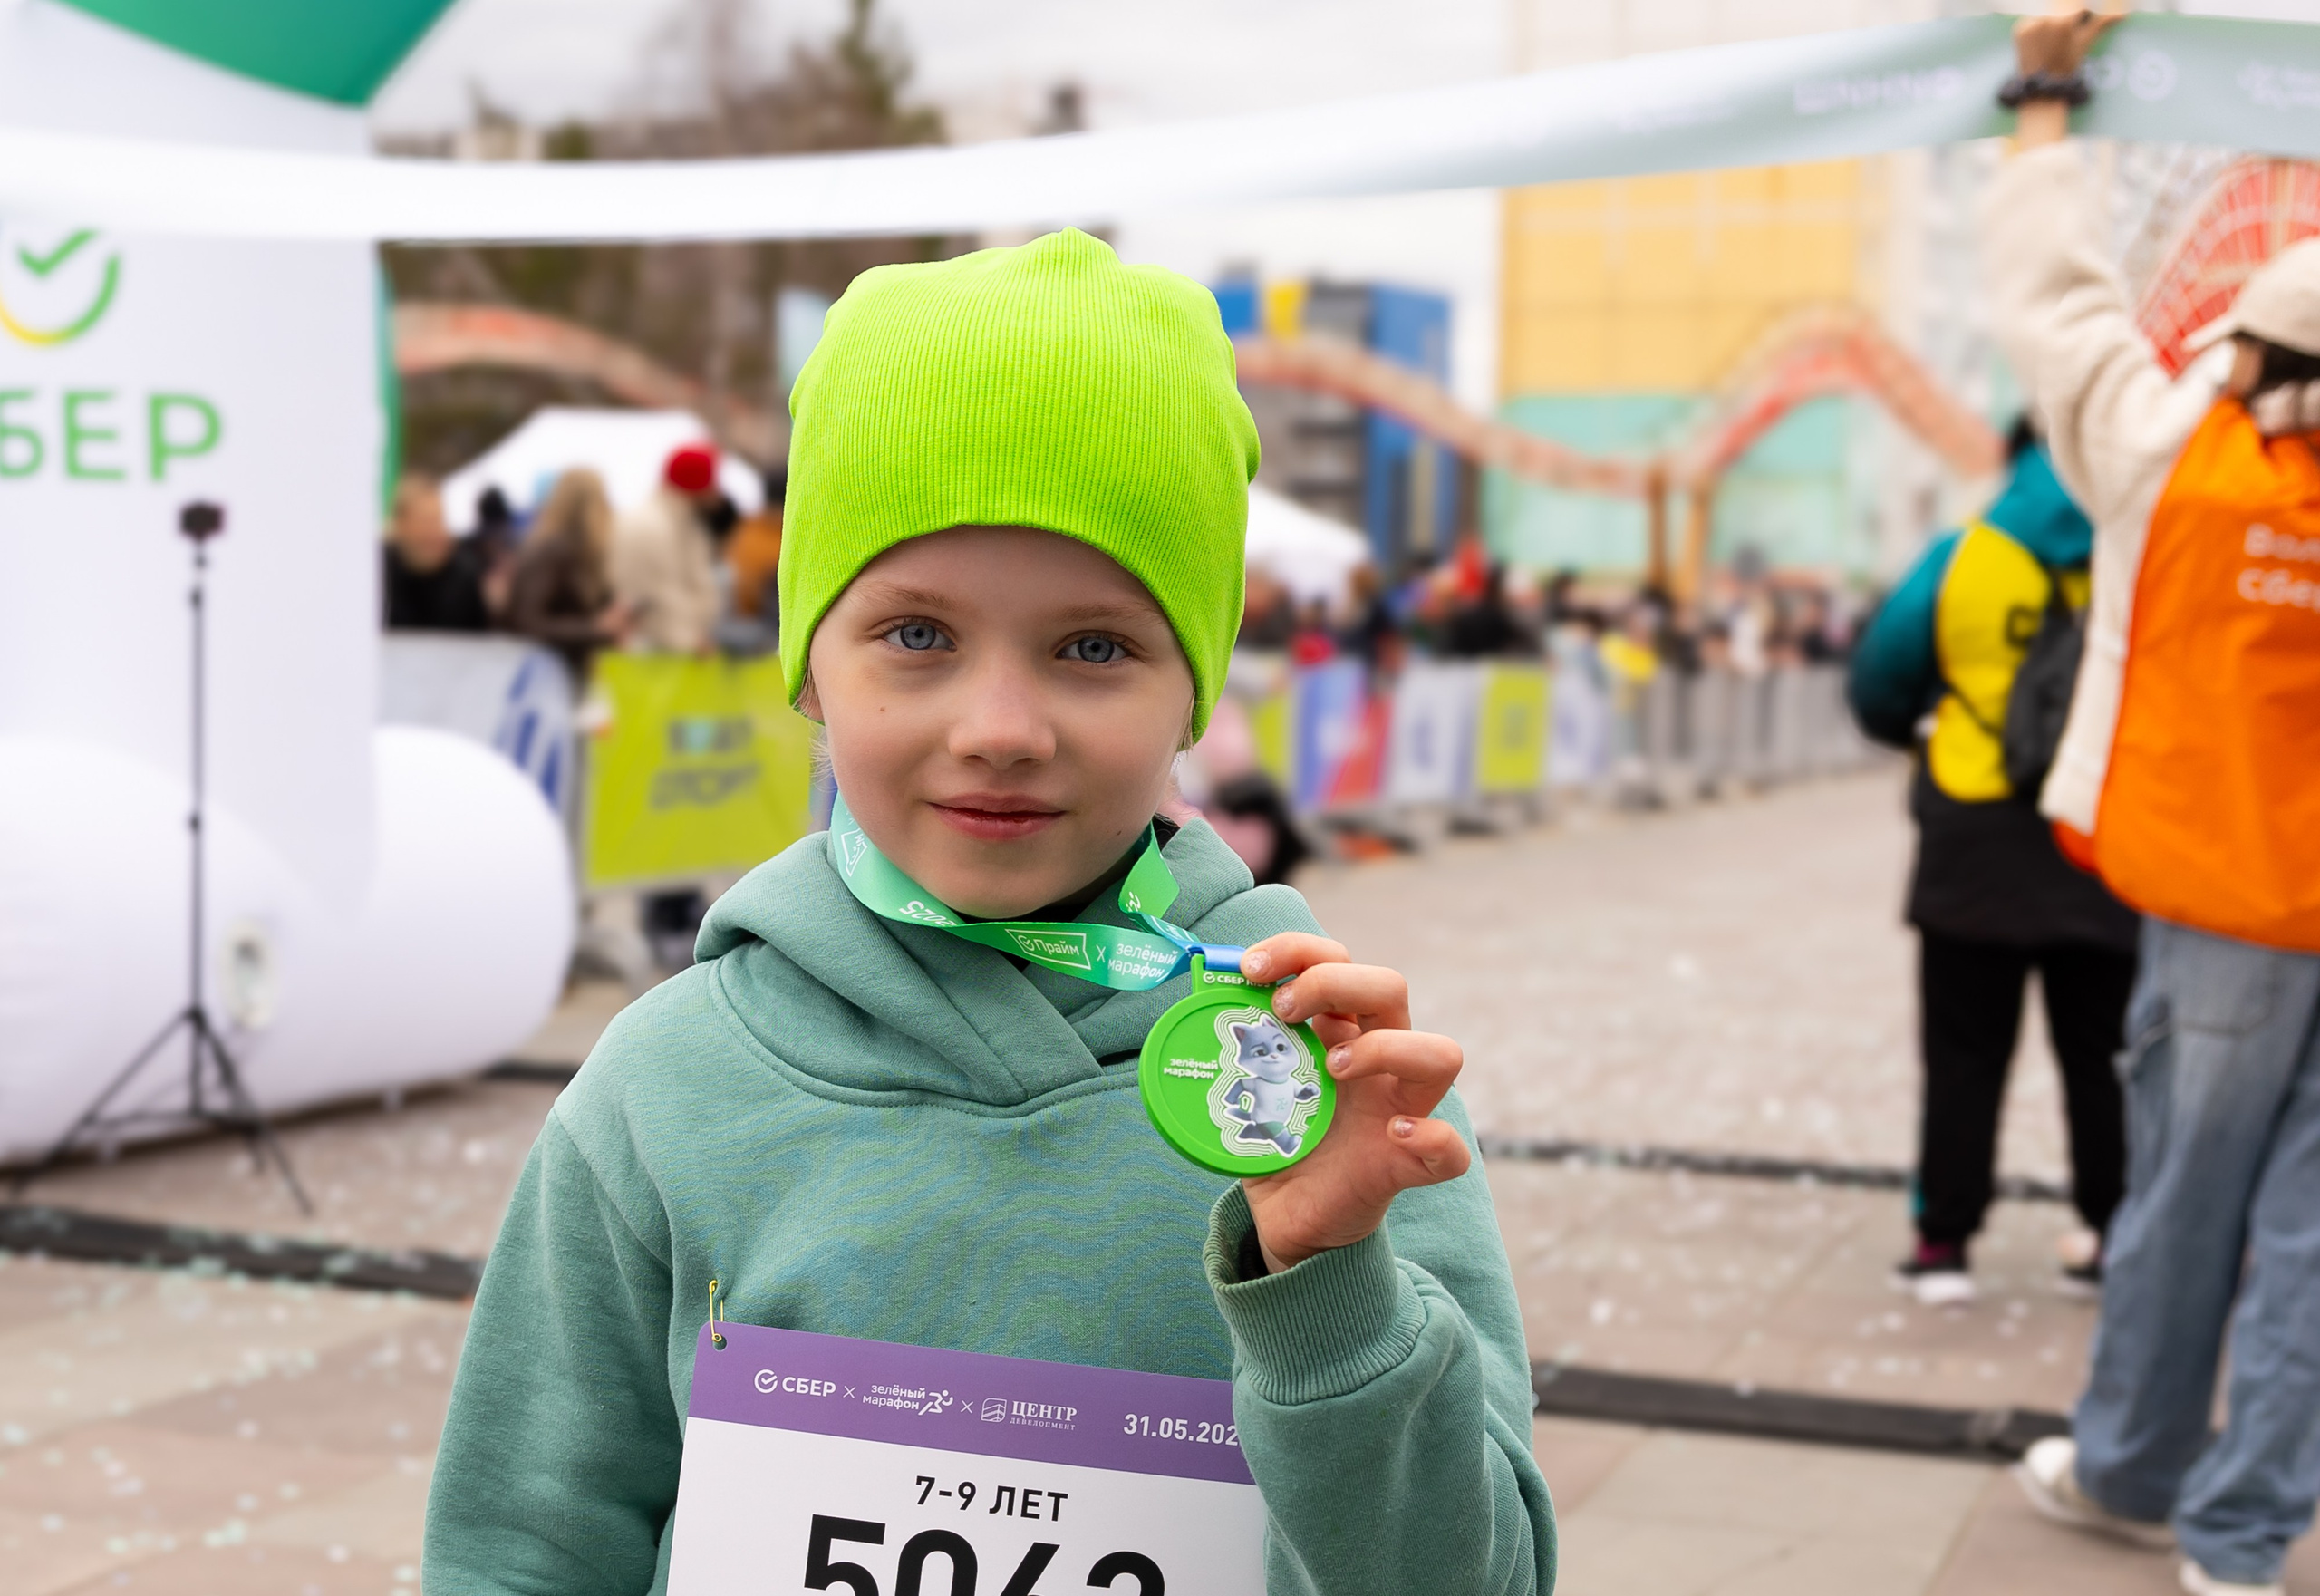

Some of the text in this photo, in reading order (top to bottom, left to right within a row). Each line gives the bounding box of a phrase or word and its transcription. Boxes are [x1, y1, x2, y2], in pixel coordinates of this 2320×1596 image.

[899, 900, 958, 927] 2025
[1033, 939, 1080, 956] Прайм
[1116, 943, 1178, 965] зелёный
[1107, 960, 1165, 980] марафон
[1217, 974, 1245, 985] СБЕР
[1163, 1067, 1214, 1079] марафон
[1169, 1058, 1219, 1070] зелёный
[782, 1376, 836, 1398] СБЕР
[871, 1383, 926, 1399] зелёный
[862, 1395, 920, 1410] марафон
[1010, 1400, 1078, 1422] ЦЕНТР
[1009, 1417, 1076, 1431] ДЕВЕЛОПМЕНТ
[1123, 1413, 1239, 1446] 31.05.202
[915, 1475, 1069, 1522] 7-9 ЛЕТ
